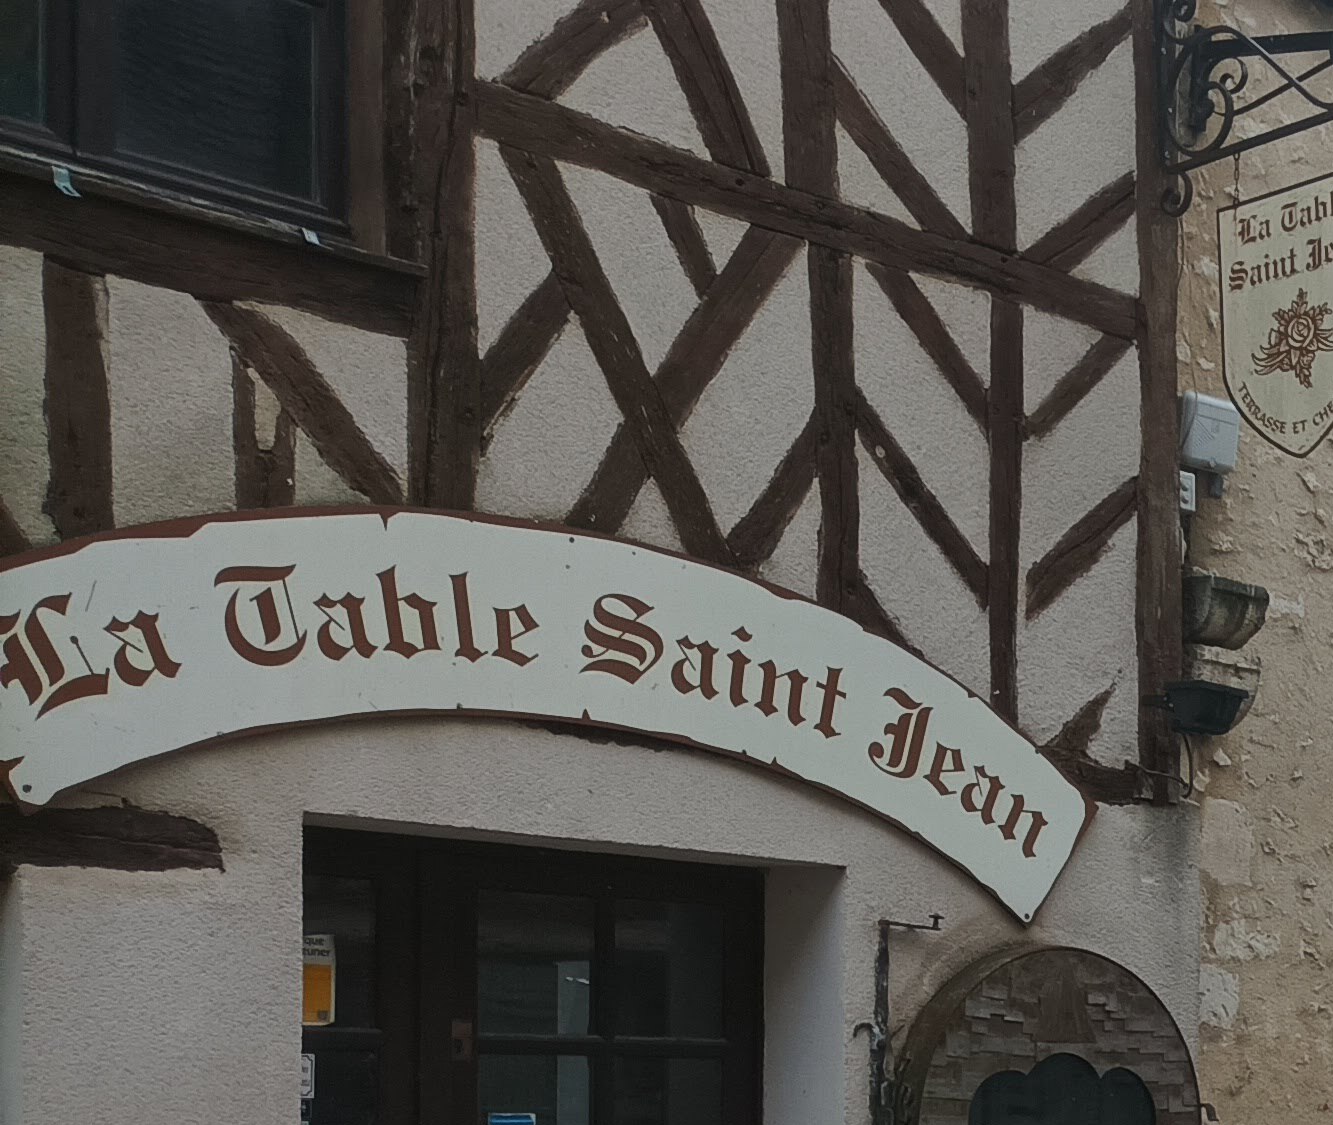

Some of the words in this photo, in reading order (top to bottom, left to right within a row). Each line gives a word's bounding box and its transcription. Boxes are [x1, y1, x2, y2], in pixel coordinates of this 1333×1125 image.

[1237, 214, 1271, 245] La
[1228, 247, 1297, 291] Saint
[1238, 381, 1286, 434] TERRASSE
[1292, 419, 1308, 434] ET
[0, 591, 182, 721] La
[213, 563, 540, 667] Table
[579, 593, 847, 739] Saint
[868, 687, 1049, 859] Jean
